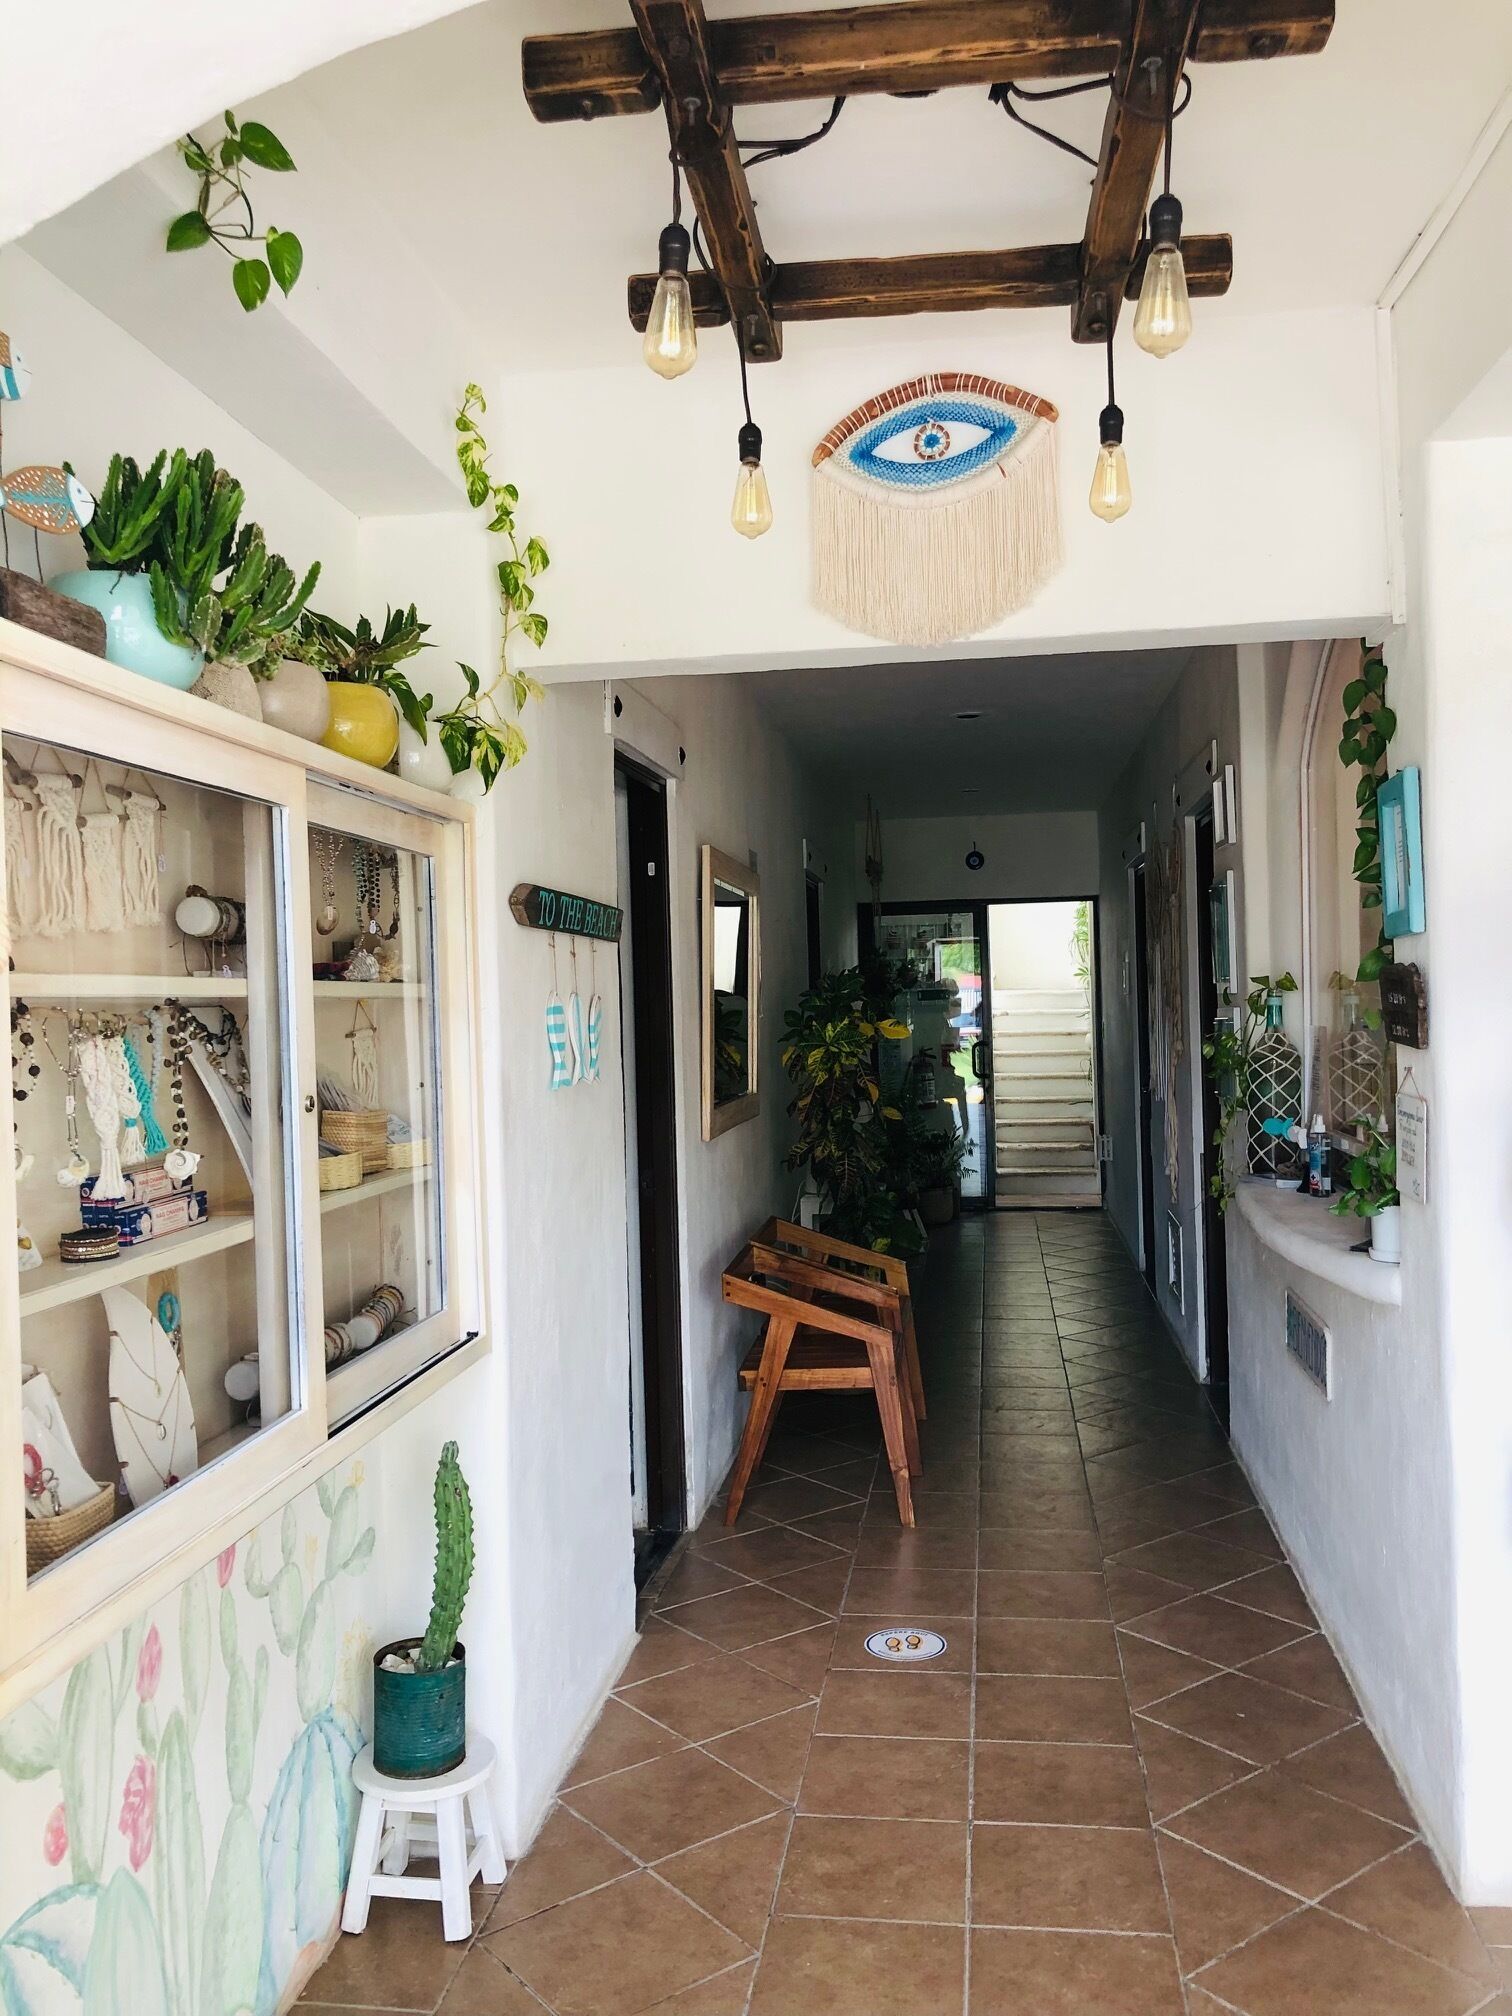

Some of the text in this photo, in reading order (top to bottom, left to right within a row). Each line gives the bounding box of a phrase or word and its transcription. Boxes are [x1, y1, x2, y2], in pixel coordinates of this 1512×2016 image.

[538, 890, 619, 938] TO THE BEACH
[156, 1211, 166, 1219] NAG
